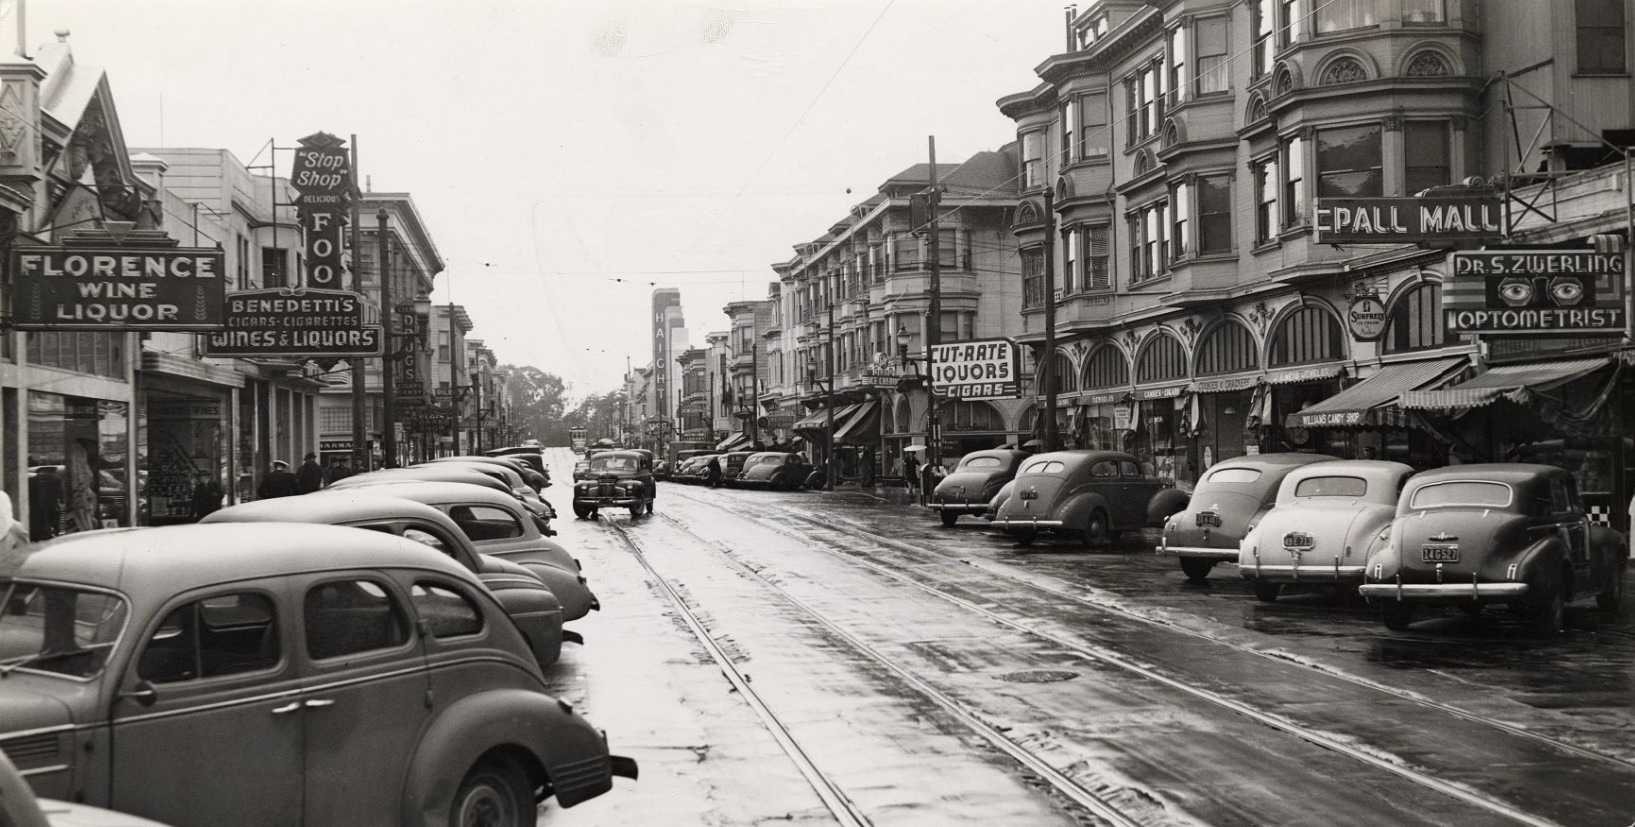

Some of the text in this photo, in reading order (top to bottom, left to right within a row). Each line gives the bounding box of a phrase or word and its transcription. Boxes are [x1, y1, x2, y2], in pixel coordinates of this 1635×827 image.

[299, 151, 344, 171] "Stop
[297, 169, 348, 190] Shop"
[303, 195, 341, 203] DELICIOUS
[1420, 204, 1498, 233] MALL
[20, 255, 216, 278] FLORENCE
[1511, 255, 1622, 274] ZWERLING
[77, 281, 157, 299] WINE
[57, 303, 179, 323] LIQUOR
[231, 297, 354, 313] BENEDETTI'S
[1457, 309, 1622, 328] OPTOMETRIST
[212, 330, 375, 349] WINES & LIQUORS
[656, 312, 665, 398] HAIGHT
[932, 362, 1009, 383] IQUORS
[948, 383, 1004, 397] CIGARS
